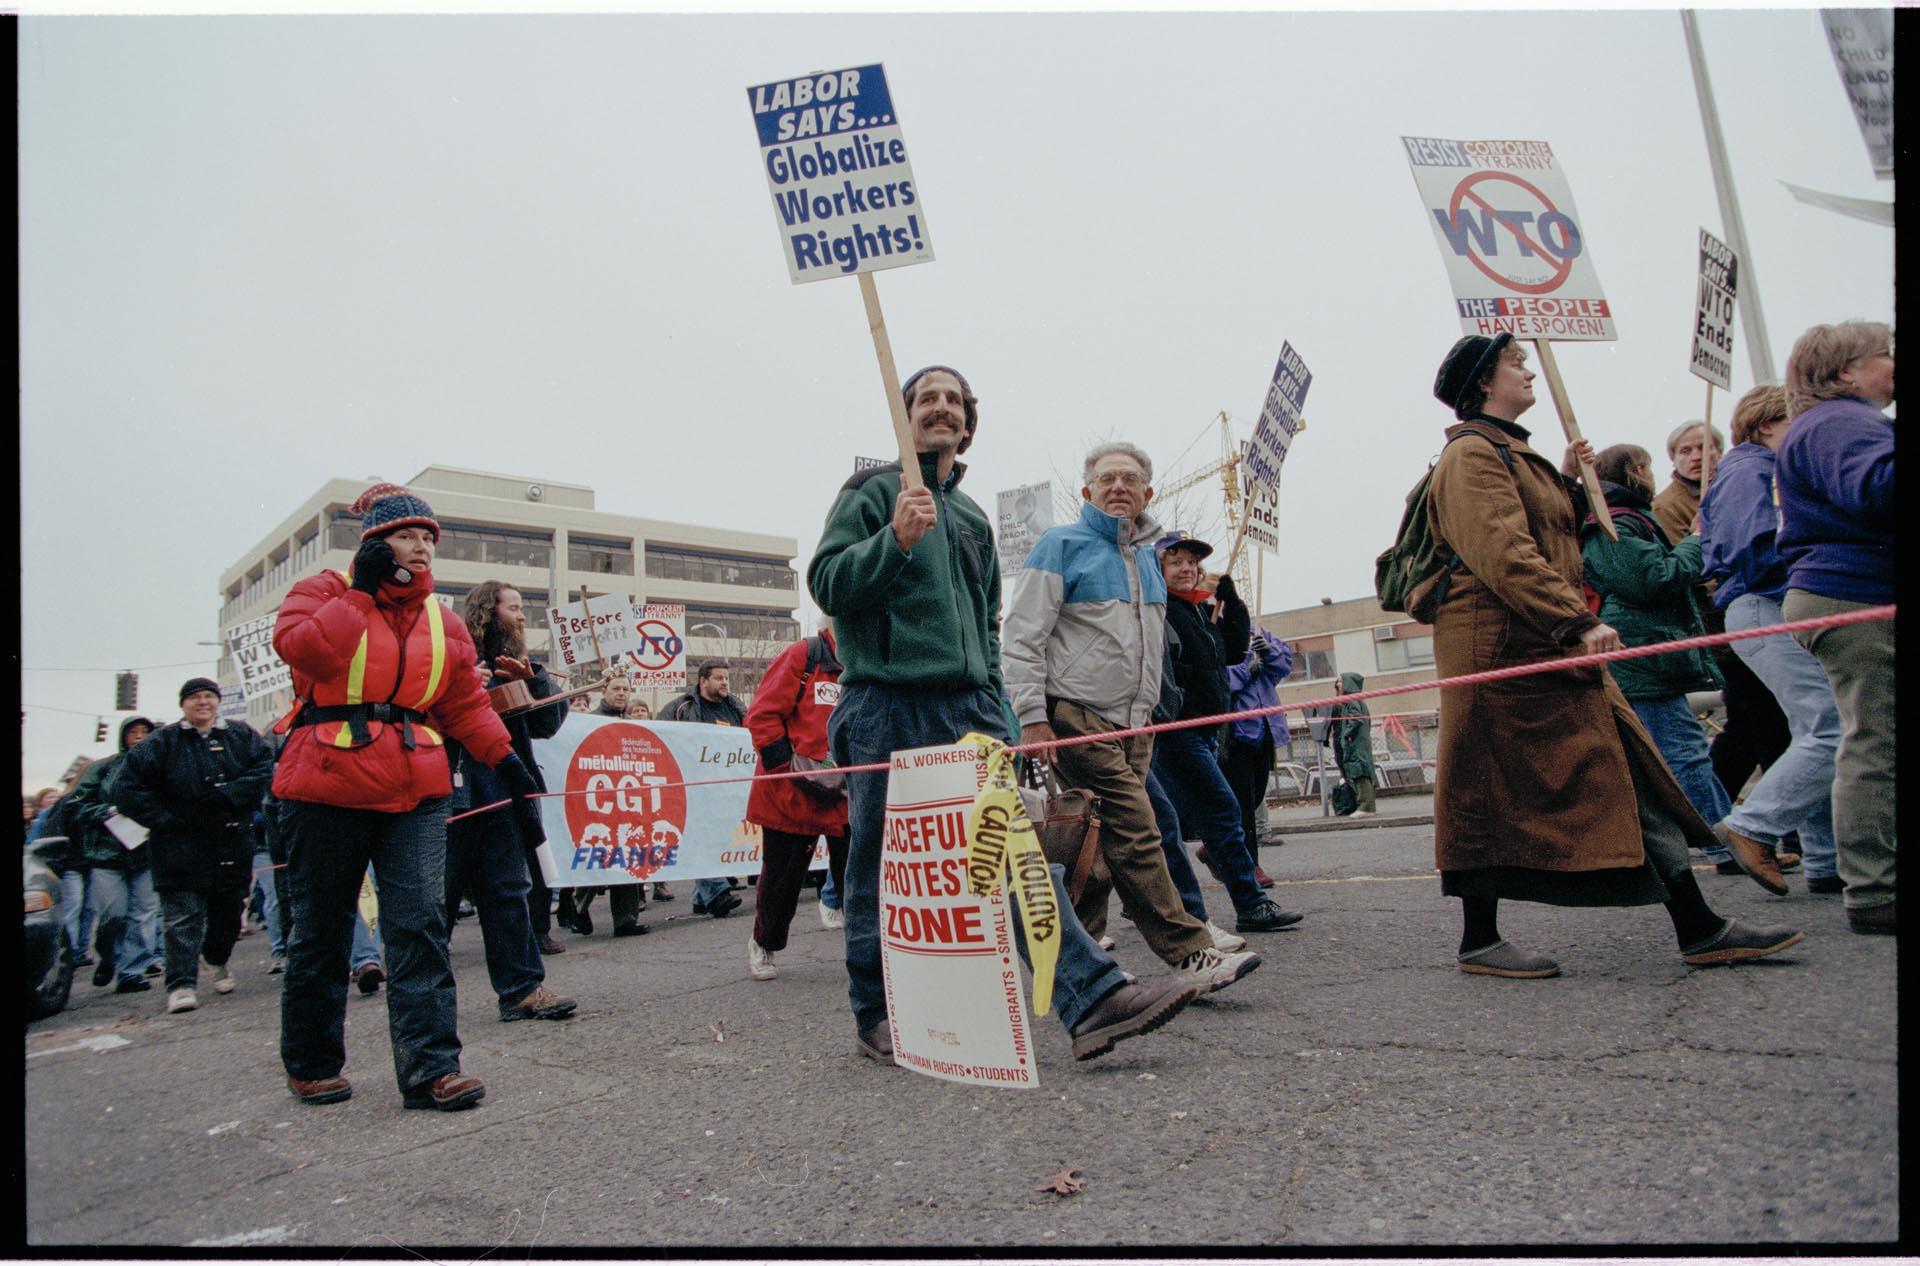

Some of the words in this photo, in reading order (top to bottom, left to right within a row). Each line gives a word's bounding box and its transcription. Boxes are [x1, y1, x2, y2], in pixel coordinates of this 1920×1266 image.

[755, 70, 861, 114] LABOR
[777, 101, 890, 141] SAYS...
[766, 134, 906, 185] Globalize
[1403, 138, 1468, 165] RESIST
[1463, 141, 1551, 156] CORPORATE
[1470, 154, 1553, 170] TYRANNY
[775, 180, 916, 226] Workers
[790, 214, 924, 273] Rights!
[1431, 208, 1582, 260] WTO
[1701, 231, 1732, 269] LABOR
[1460, 299, 1498, 316] THE
[1504, 299, 1602, 316] PEOPLE
[1700, 279, 1734, 326] WTO
[1476, 317, 1529, 336] HAVE
[1532, 317, 1605, 336] SPOKEN!
[1697, 311, 1732, 354] Ends
[1280, 344, 1308, 387] LABOR
[1266, 385, 1298, 439] Globalize
[1255, 414, 1287, 463] Workers
[1246, 442, 1280, 490] Rights!
[1000, 513, 1012, 521] NO
[1000, 521, 1022, 530] CHILD
[646, 604, 685, 613] CORPORATE
[237, 641, 273, 665] WT
[244, 671, 292, 696] Democr
[641, 671, 685, 679] PEOPLE
[578, 754, 655, 776] métallurgie
[700, 746, 721, 763] Le
[893, 757, 911, 771] AL
[914, 749, 975, 767] WORKERS
[586, 774, 667, 816] CGT
[570, 845, 680, 870] FRANCE
[720, 845, 760, 864] and
[885, 903, 985, 943] ZONE
[993, 908, 1010, 953] SMALL
[1003, 970, 1028, 1056] IMMIGRANTS
[891, 1018, 903, 1058] LABOR
[906, 1052, 932, 1070] HUMAN
[934, 1060, 966, 1077] RIGHTS
[972, 1065, 1029, 1082] STUDENTS
